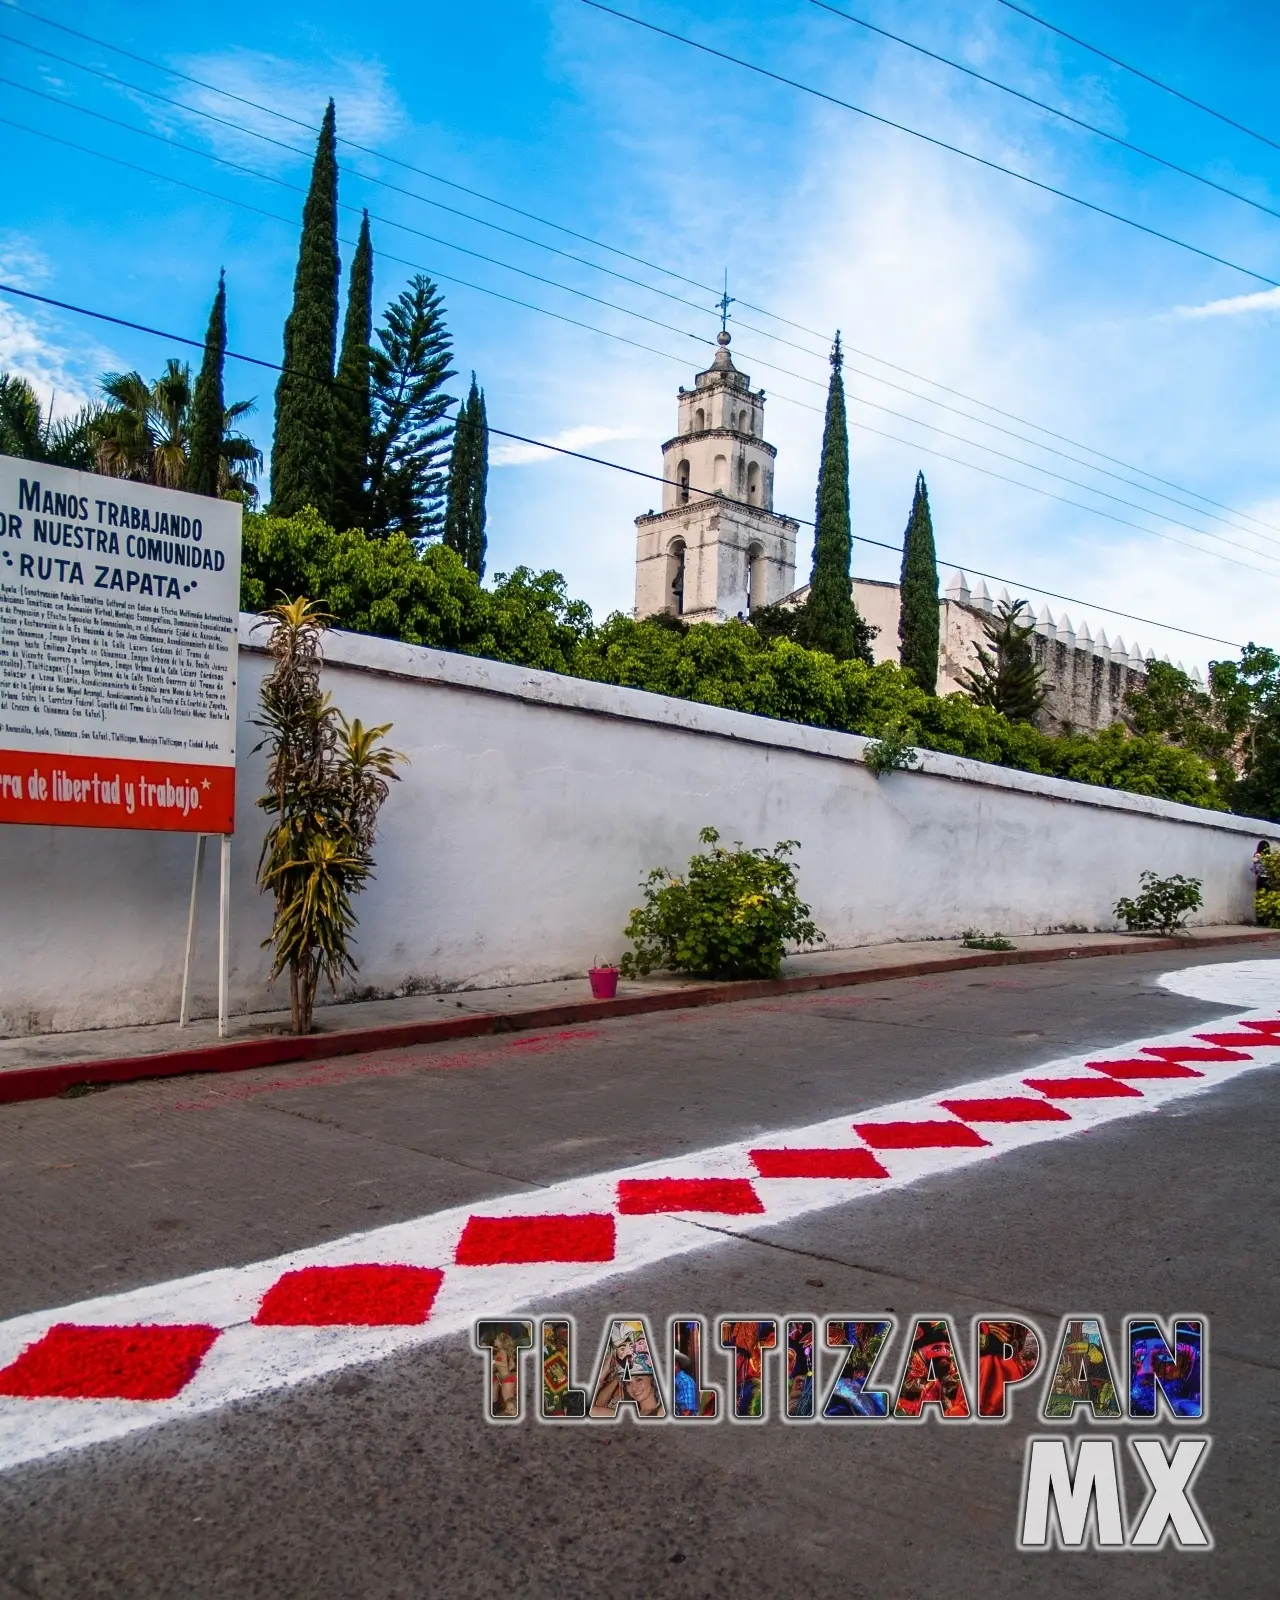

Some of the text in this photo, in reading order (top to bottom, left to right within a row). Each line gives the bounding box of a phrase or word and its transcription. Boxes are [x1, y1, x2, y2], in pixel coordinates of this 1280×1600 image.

[19, 478, 203, 541] MANOS TRABAJANDO
[33, 518, 120, 555] NUESTRA
[126, 534, 225, 571] COMUNIDAD
[20, 553, 181, 600] RUTA ZAPATA
[5, 605, 11, 613] de
[47, 610, 67, 621] Efectos
[144, 624, 149, 632] el
[191, 629, 198, 638] de
[153, 604, 159, 613] de
[1, 626, 15, 636] Juan
[49, 632, 68, 643] Imagen
[70, 635, 90, 645] Urbana
[93, 637, 99, 646] de
[101, 638, 108, 647] la
[112, 640, 125, 649] Calle
[129, 642, 148, 652] Lázaro
[151, 644, 173, 655] Cárdenas
[186, 649, 202, 658] Tramo
[203, 651, 210, 660] de
[59, 622, 64, 631] de
[66, 623, 72, 632] la
[74, 624, 81, 633] Ex
[83, 625, 105, 636] Hacienda
[107, 628, 113, 637] de
[116, 629, 124, 638] San
[127, 631, 137, 640] Juan
[1, 636, 20, 648] Amaya
[24, 639, 39, 648] hasta
[67, 644, 87, 655] Zapata
[131, 652, 148, 663] Imagen
[151, 654, 170, 664] Urbana
[171, 656, 177, 665] de
[179, 657, 184, 666] la
[186, 658, 194, 667] Av.
[195, 659, 210, 669] Benito
[12, 648, 19, 657] de
[21, 649, 44, 660] Vicente
[47, 652, 71, 663] Guerrero
[115, 660, 132, 671] Imagen
[134, 662, 152, 672] Urbana
[154, 664, 160, 673] de
[160, 665, 166, 673] la
[167, 666, 178, 675] Calle
[180, 667, 197, 677] Lázaro
[200, 670, 224, 680] Cárdenas
[3, 668, 26, 679] Salazar
[131, 682, 137, 690] de
[139, 683, 157, 693] Espacio
[172, 686, 185, 695] Museo
[186, 688, 191, 696] de
[193, 688, 204, 697] Arte
[205, 690, 218, 699] Sacro
[13, 680, 19, 689] de
[21, 681, 27, 689] la
[28, 682, 46, 692] Iglesia
[48, 684, 54, 692] de
[56, 685, 65, 693] San
[67, 686, 81, 696] Miguel
[144, 694, 149, 702] de
[180, 697, 186, 706] Ex
[202, 700, 208, 708] de
[94, 668, 113, 678] Urbana
[116, 670, 122, 679] de
[124, 671, 129, 680] la
[131, 672, 144, 681] Calle
[146, 674, 164, 683] Vicente
[166, 676, 187, 686] Guerrero
[199, 679, 215, 689] Tramo
[216, 681, 223, 690] de
[1, 690, 18, 699] Urbana
[39, 694, 44, 702] la
[48, 695, 73, 705] Carretera
[75, 697, 94, 707] Federal
[97, 699, 118, 709] Cuautla
[129, 703, 144, 712] Tramo
[145, 704, 151, 712] de
[151, 705, 157, 713] la
[159, 706, 172, 714] Calle
[209, 710, 223, 720] Hasta
[224, 712, 230, 720] la
[11, 702, 30, 712] Crucero
[33, 704, 40, 713] de
[43, 705, 69, 715] Chinameca
[72, 708, 82, 716] San
[81, 730, 90, 738] San
[188, 739, 204, 748] Ciudad
[0, 773, 23, 799] ra
[28, 768, 47, 801] de
[52, 769, 120, 805] libertad
[125, 782, 135, 814] y
